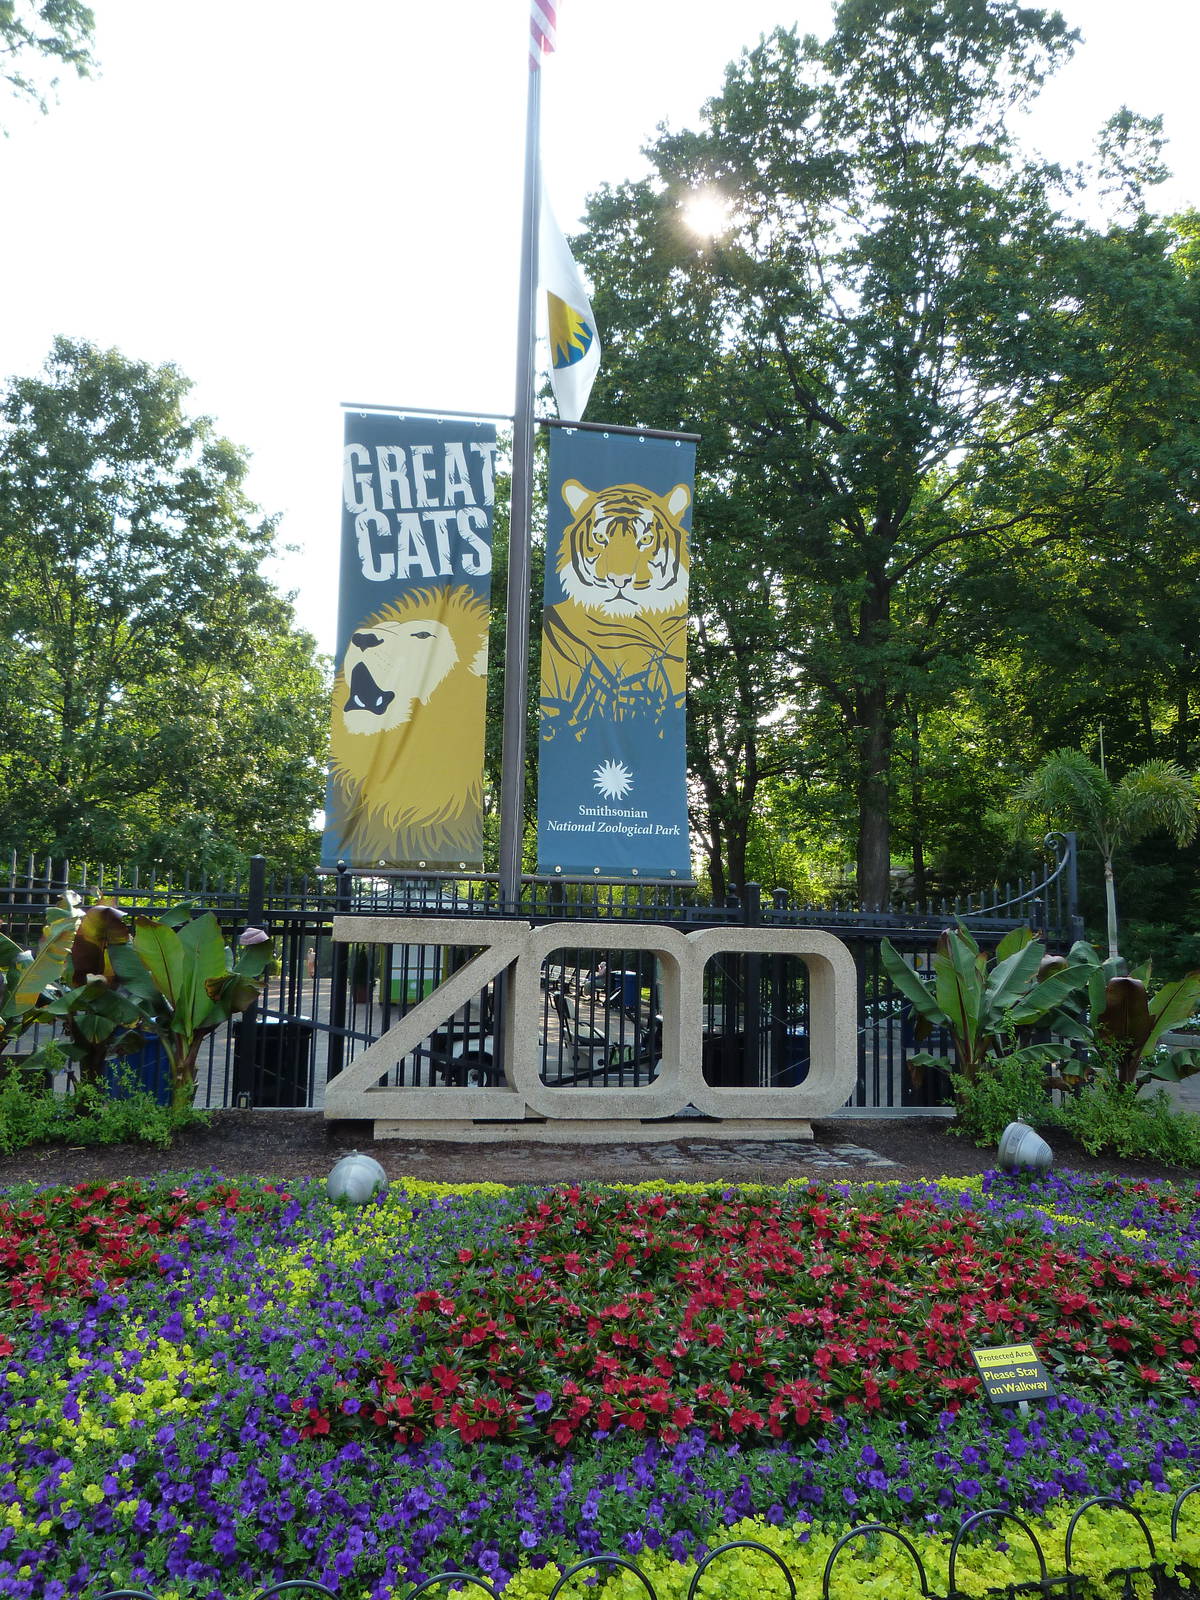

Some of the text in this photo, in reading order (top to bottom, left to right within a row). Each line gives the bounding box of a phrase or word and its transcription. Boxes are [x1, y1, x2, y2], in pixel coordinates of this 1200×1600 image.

[343, 442, 497, 514] GREAT
[355, 507, 493, 582] CATS
[578, 805, 648, 818] Smithsonian
[546, 820, 680, 837] National Zoological Park
[324, 917, 857, 1119] ZOO
[978, 1350, 1033, 1362] Protected Area
[983, 1367, 1038, 1380] Please Stay
[990, 1381, 1047, 1395] on Walkway
